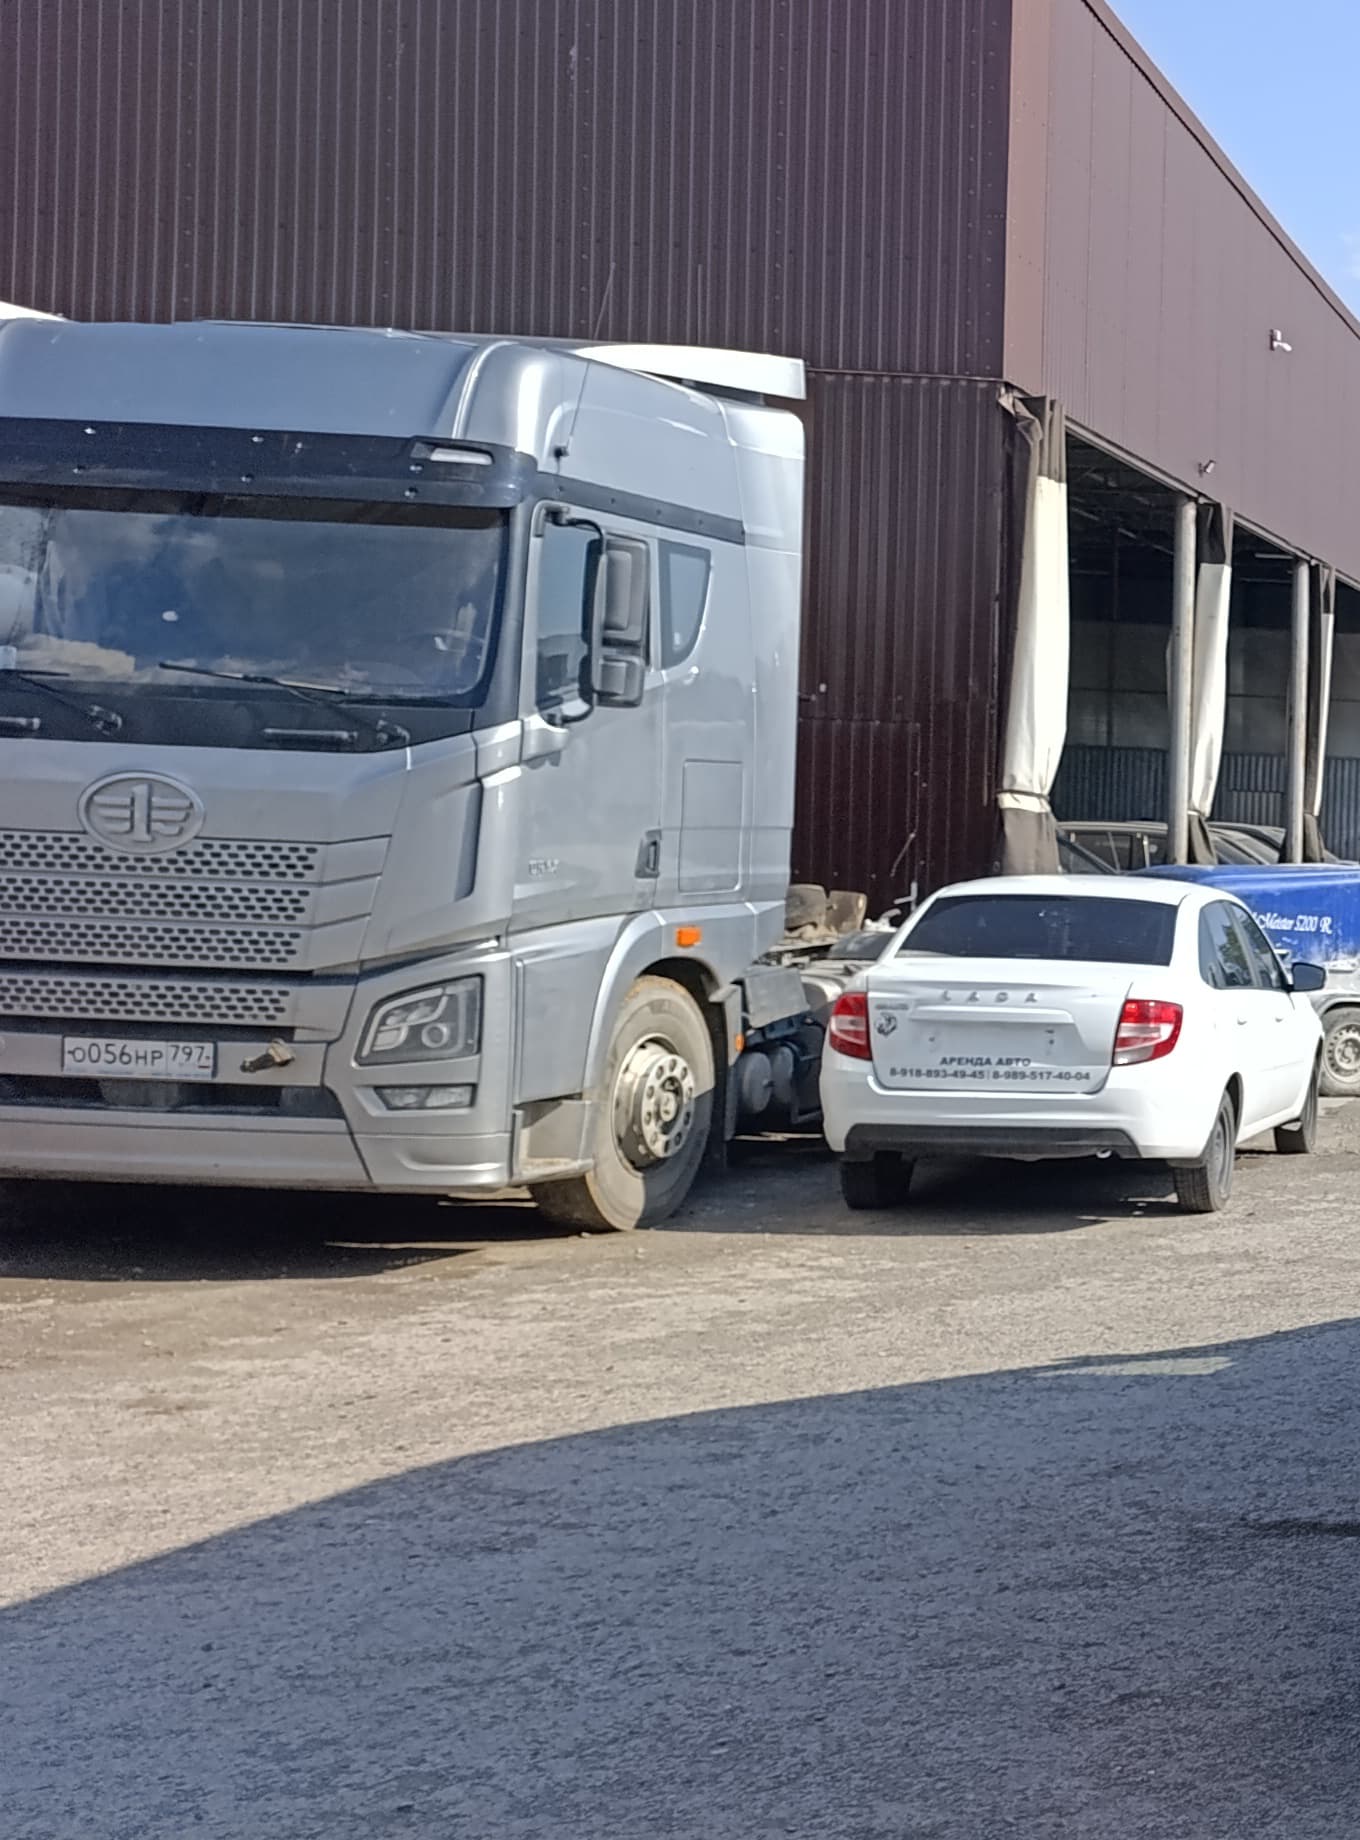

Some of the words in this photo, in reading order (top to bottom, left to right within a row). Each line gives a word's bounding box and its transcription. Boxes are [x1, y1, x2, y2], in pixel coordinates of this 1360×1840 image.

[1294, 914, 1318, 931] 5200
[1320, 916, 1333, 934] R
[940, 990, 1038, 1004] LADA
[169, 1044, 205, 1063] 797
[939, 1056, 992, 1067] АРЕНДА
[996, 1057, 1031, 1068] АВТО
